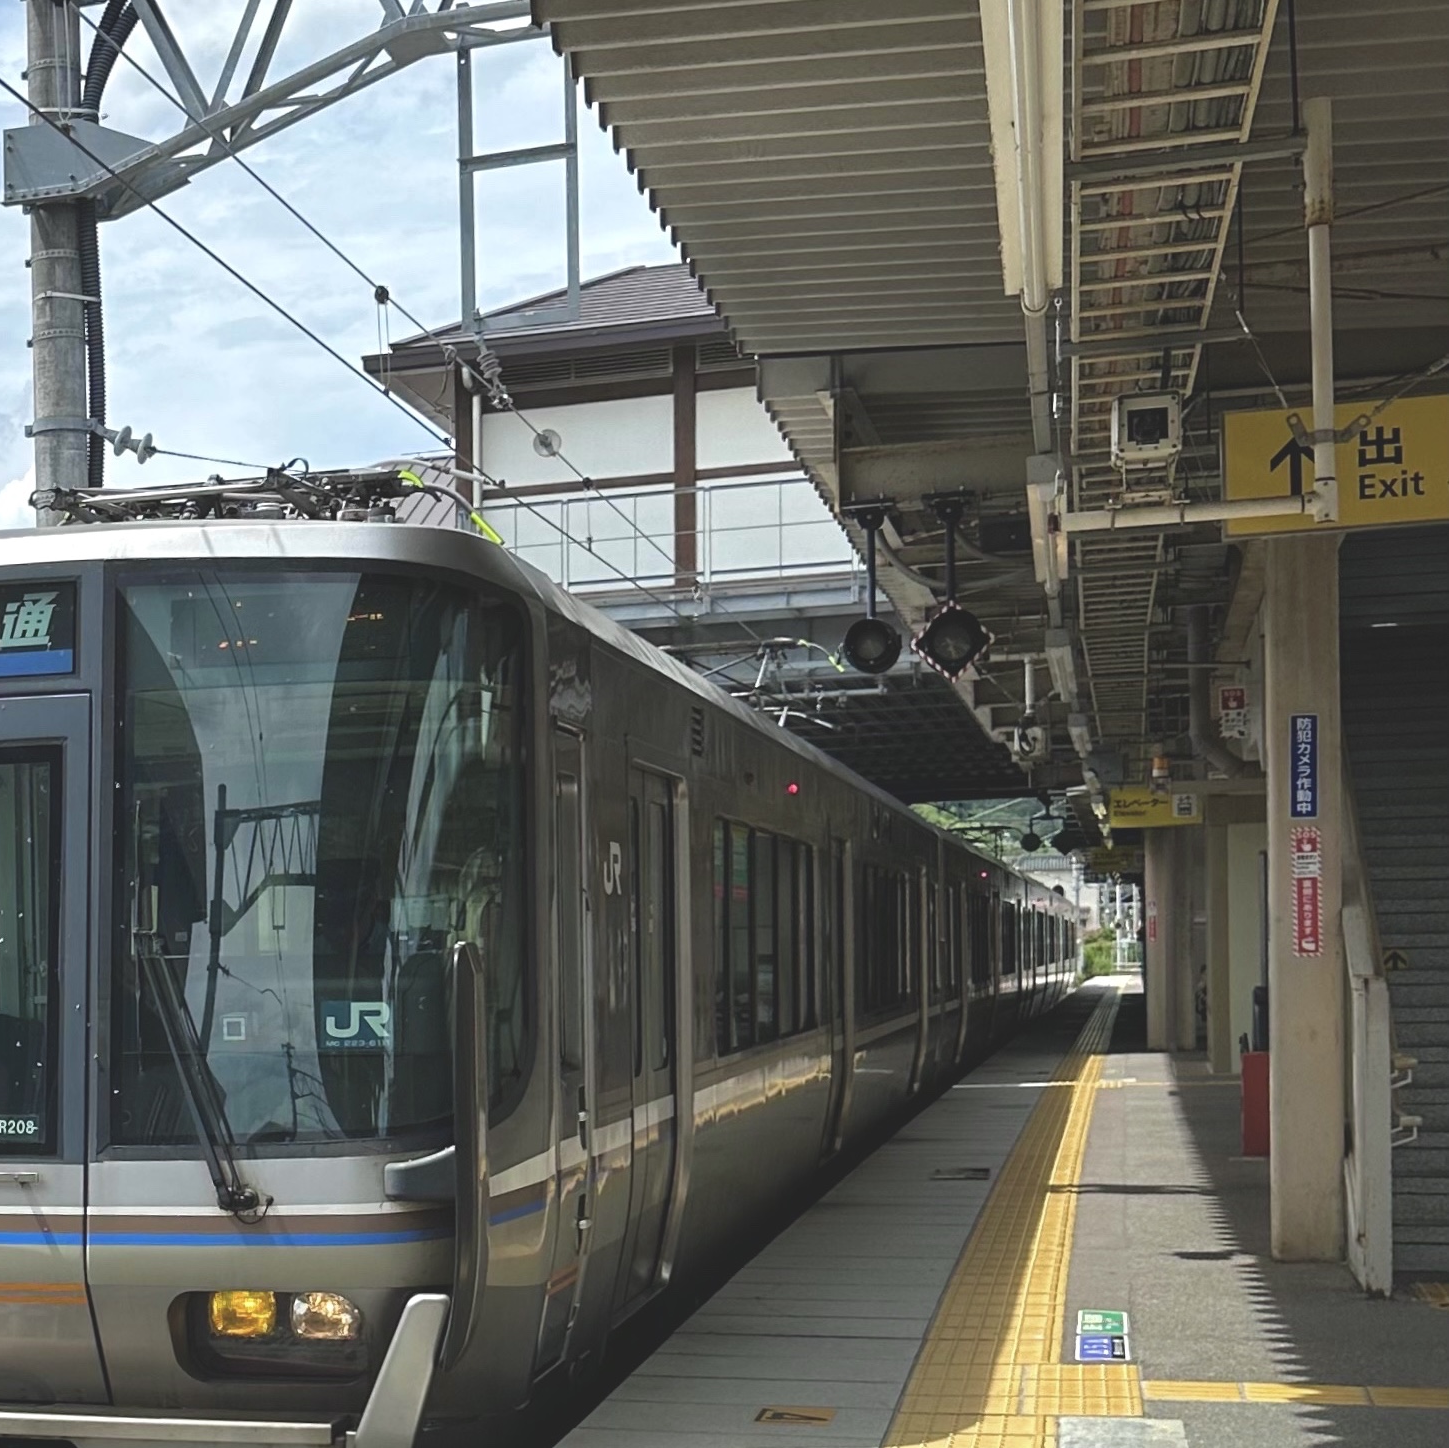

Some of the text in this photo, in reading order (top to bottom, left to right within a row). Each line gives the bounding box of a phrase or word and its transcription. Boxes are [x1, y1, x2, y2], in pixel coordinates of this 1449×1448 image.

[1358, 426, 1403, 467] 出
[1359, 470, 1425, 500] Exit
[1296, 717, 1313, 815] 防犯カメラ作動中
[603, 841, 622, 896] JR
[325, 1002, 391, 1038] JR
